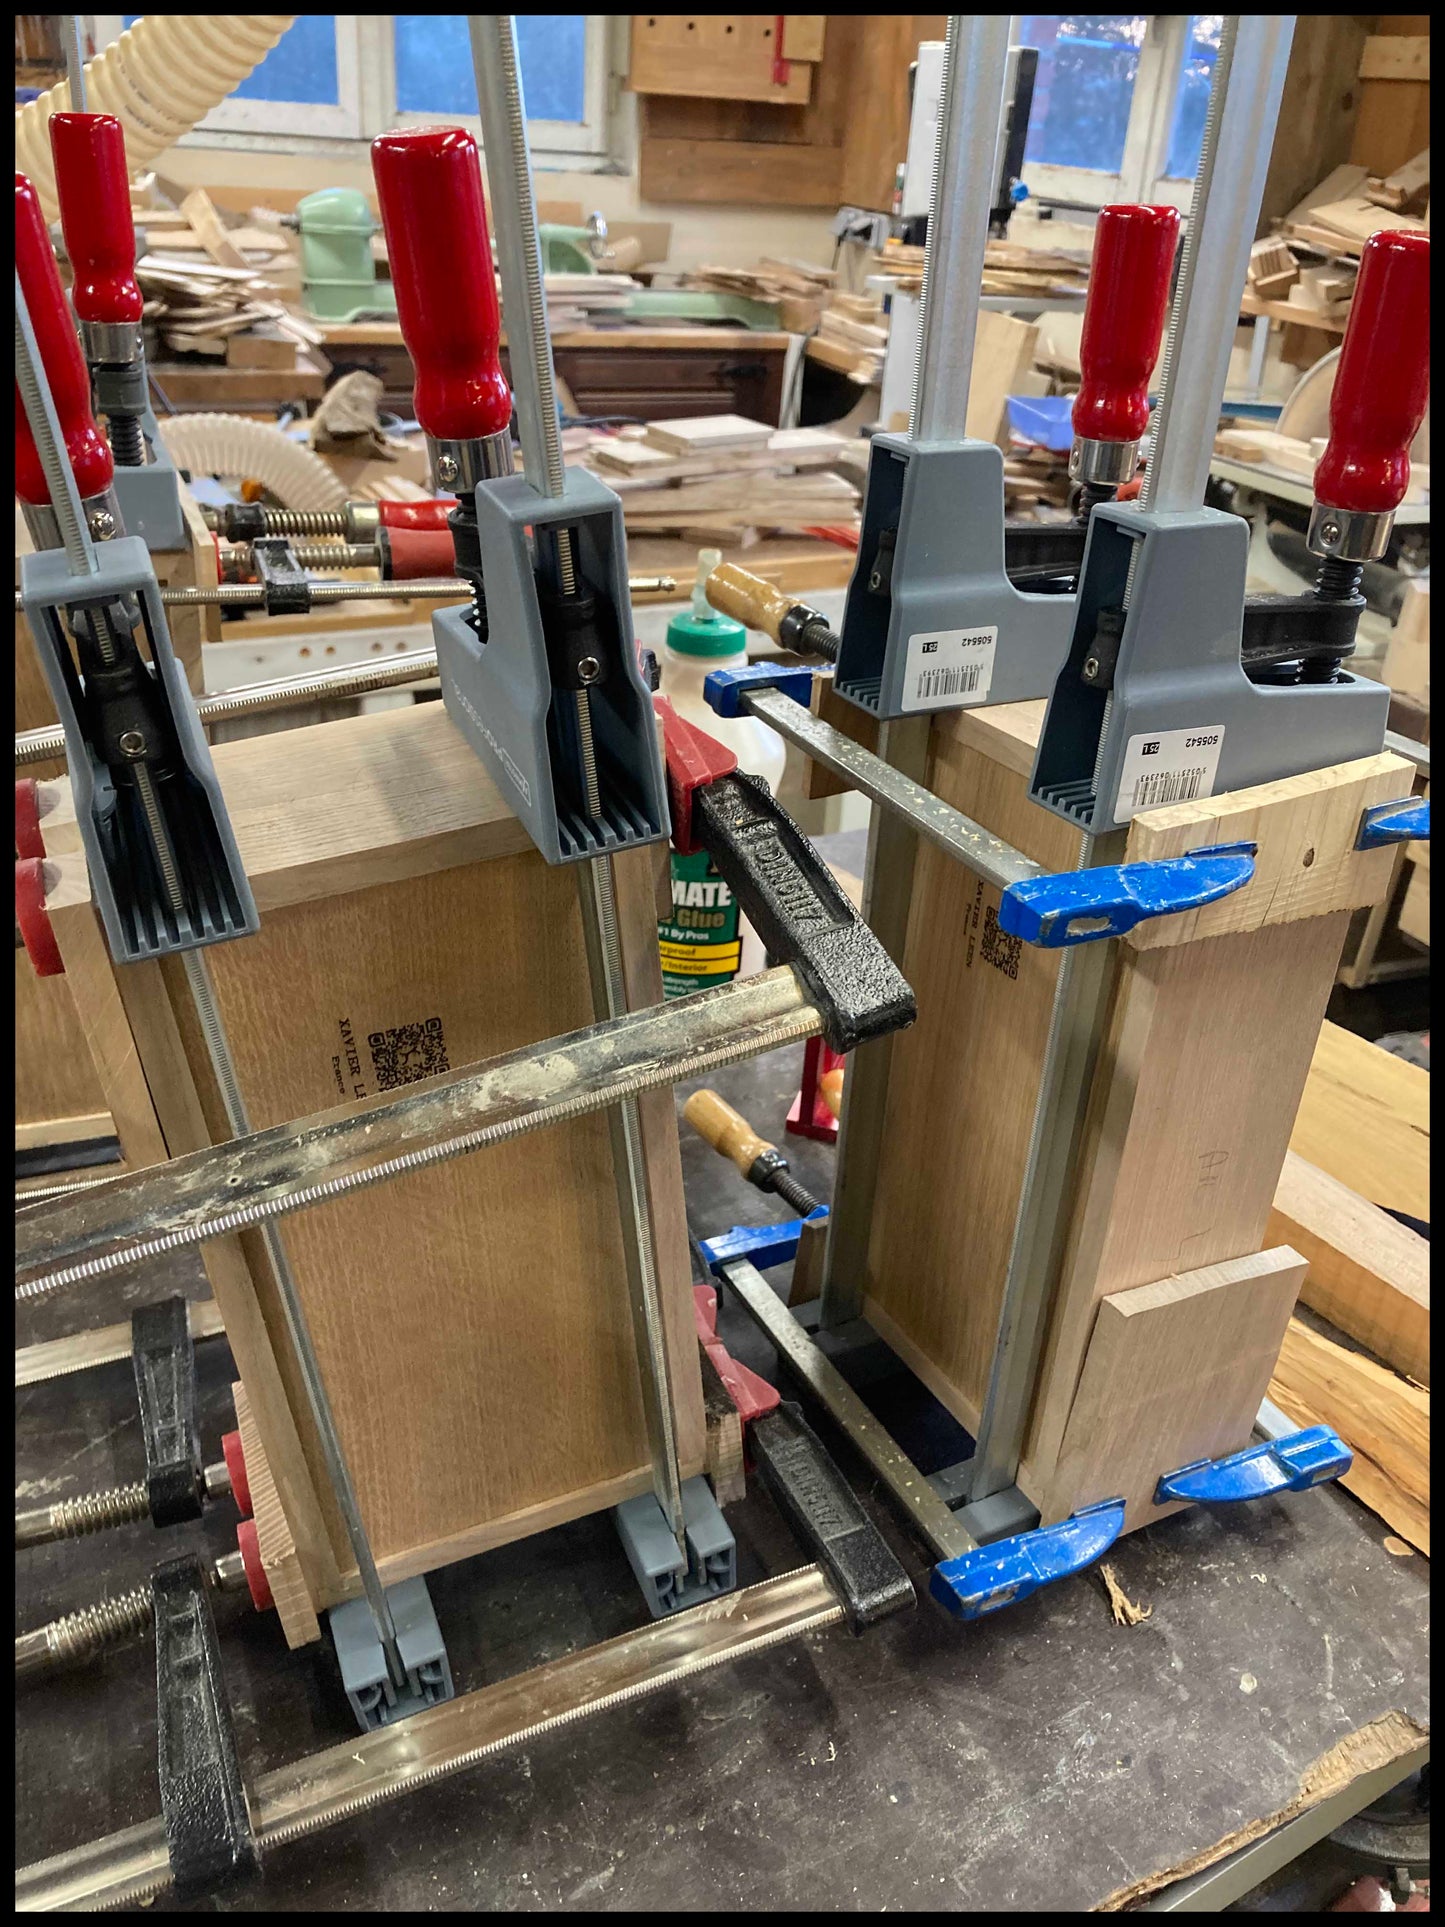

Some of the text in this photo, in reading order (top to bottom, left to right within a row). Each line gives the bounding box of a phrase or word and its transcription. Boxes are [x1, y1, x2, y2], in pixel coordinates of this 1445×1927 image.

[962, 635, 992, 647] 505542
[1185, 735, 1219, 748] 505542
[677, 909, 725, 928] Glue
[670, 928, 685, 941] By
[685, 930, 710, 940] Pros
[339, 1018, 361, 1077] XAVIER
[332, 1055, 345, 1094] France
